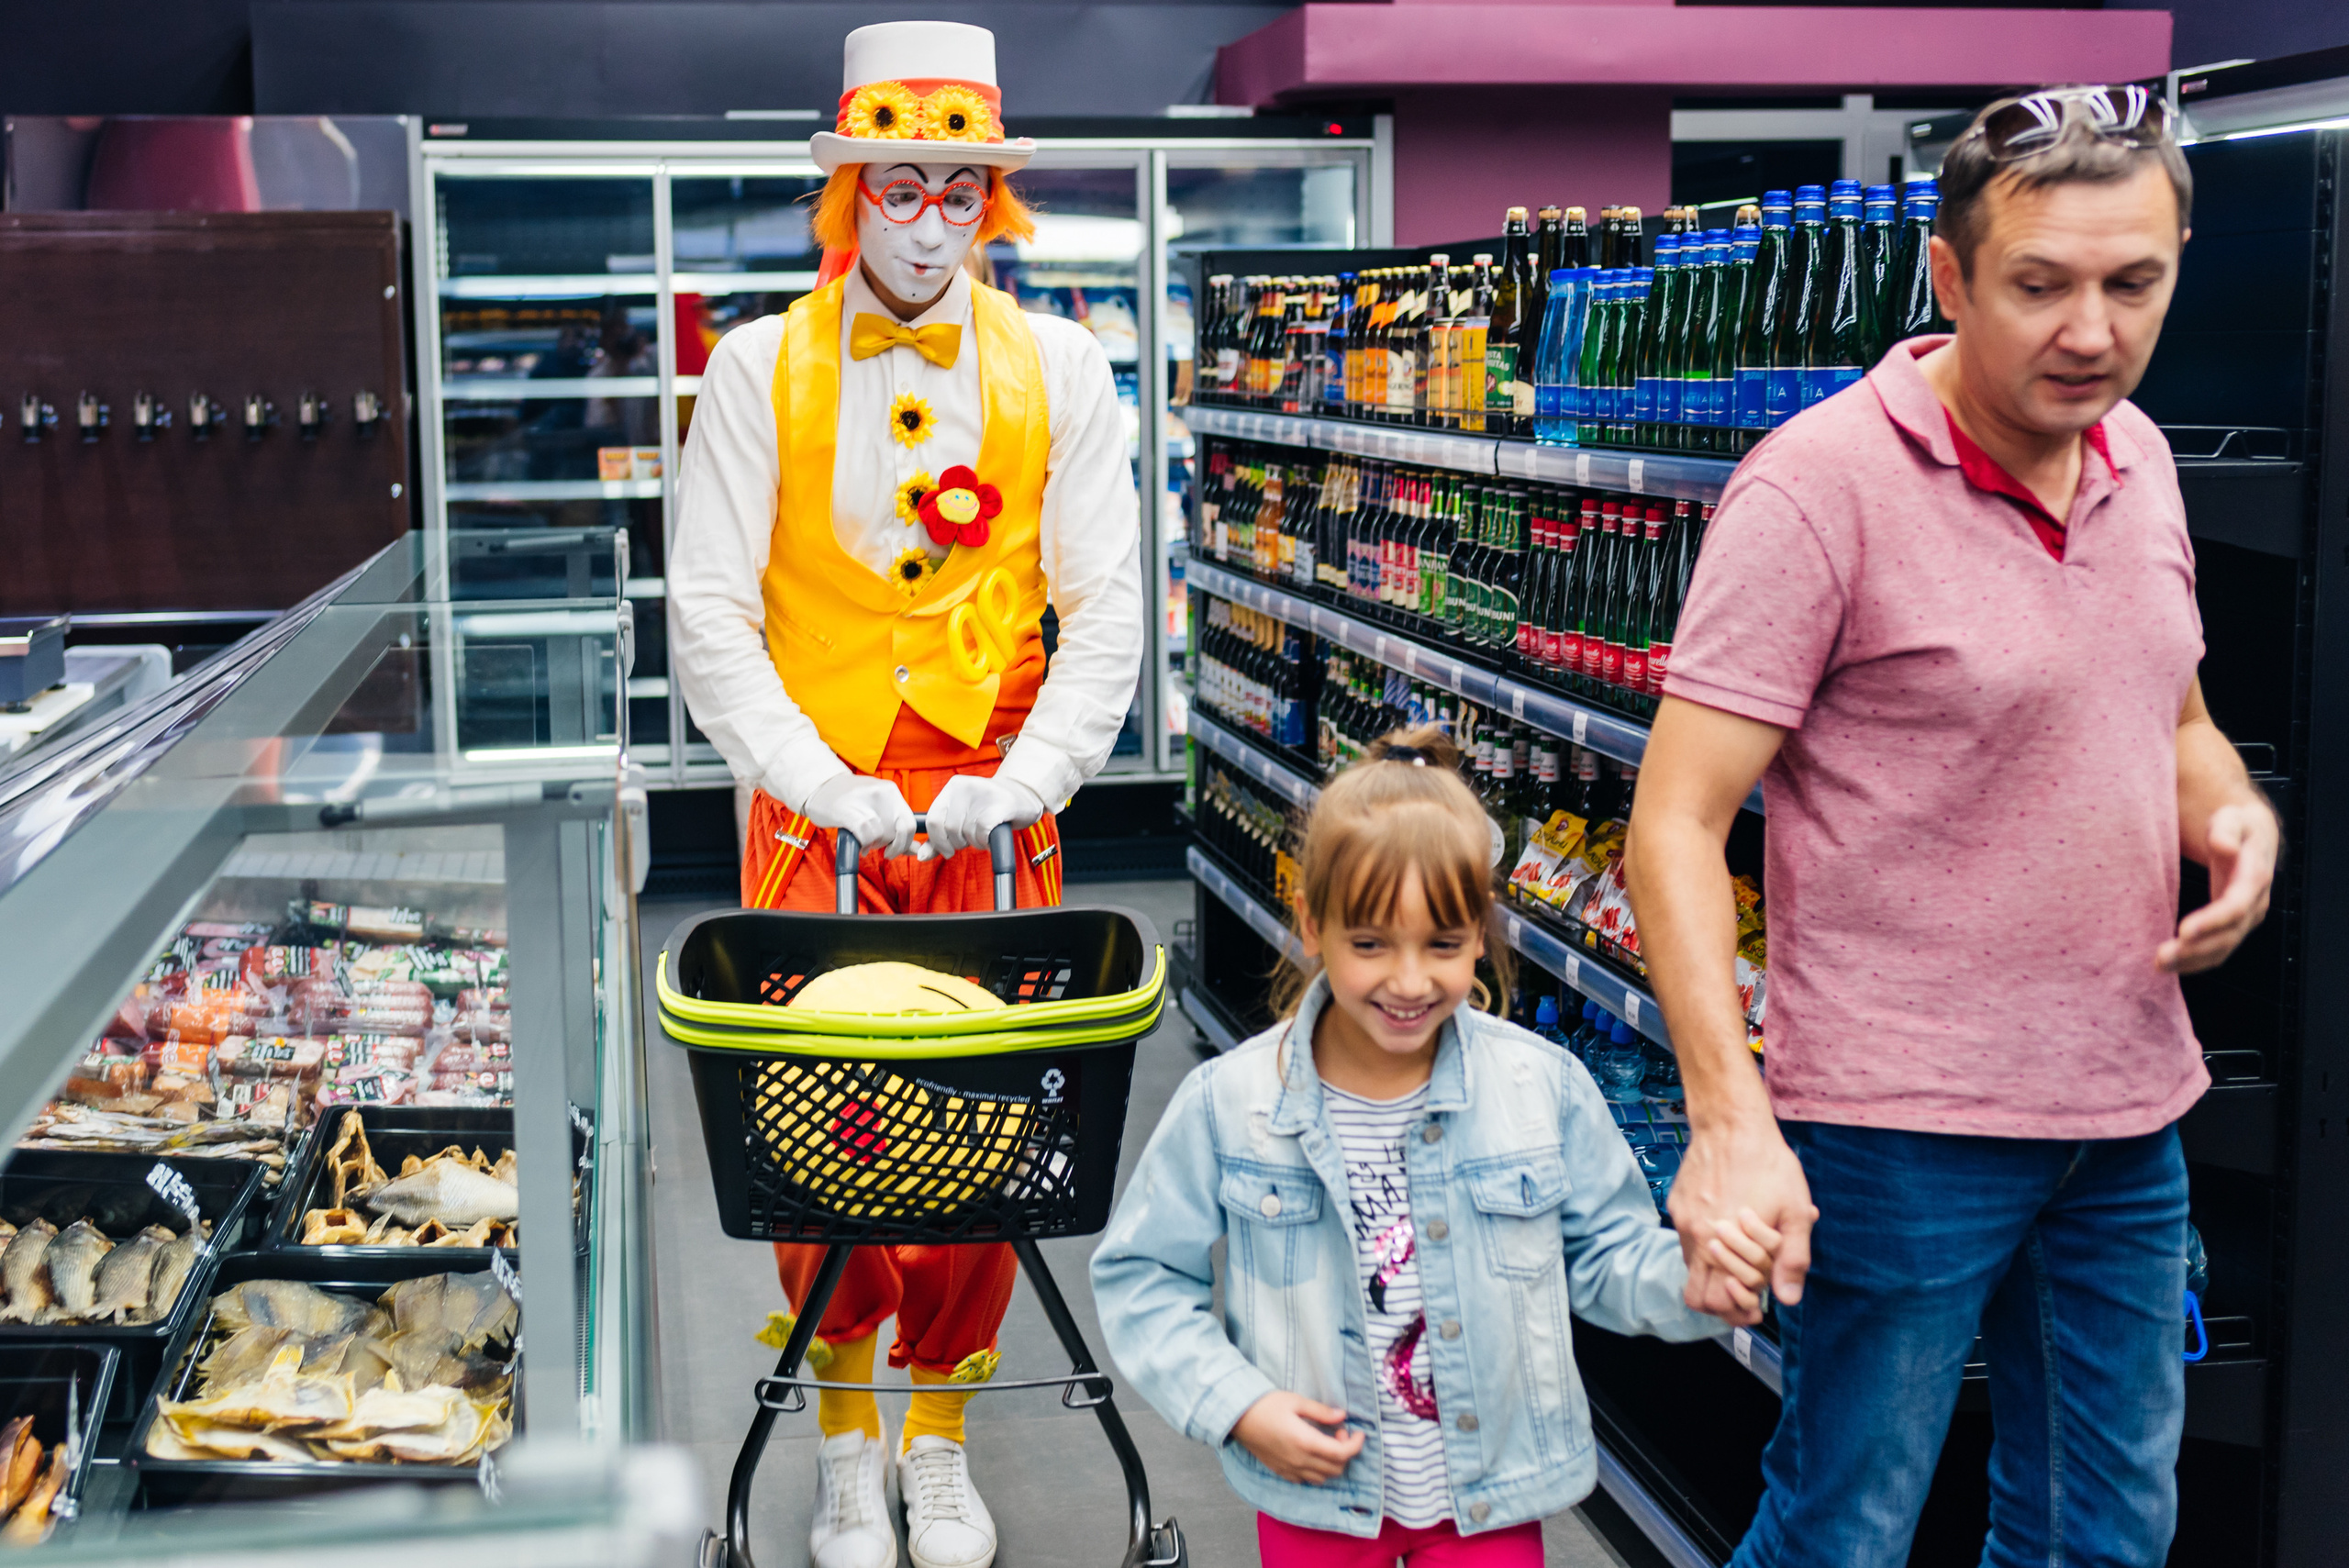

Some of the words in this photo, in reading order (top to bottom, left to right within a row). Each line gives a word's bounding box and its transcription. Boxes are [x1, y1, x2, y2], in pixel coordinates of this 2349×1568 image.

[916, 1076, 958, 1097] ecofriendly
[963, 1090, 996, 1101] maximal
[997, 1093, 1031, 1104] recycled
